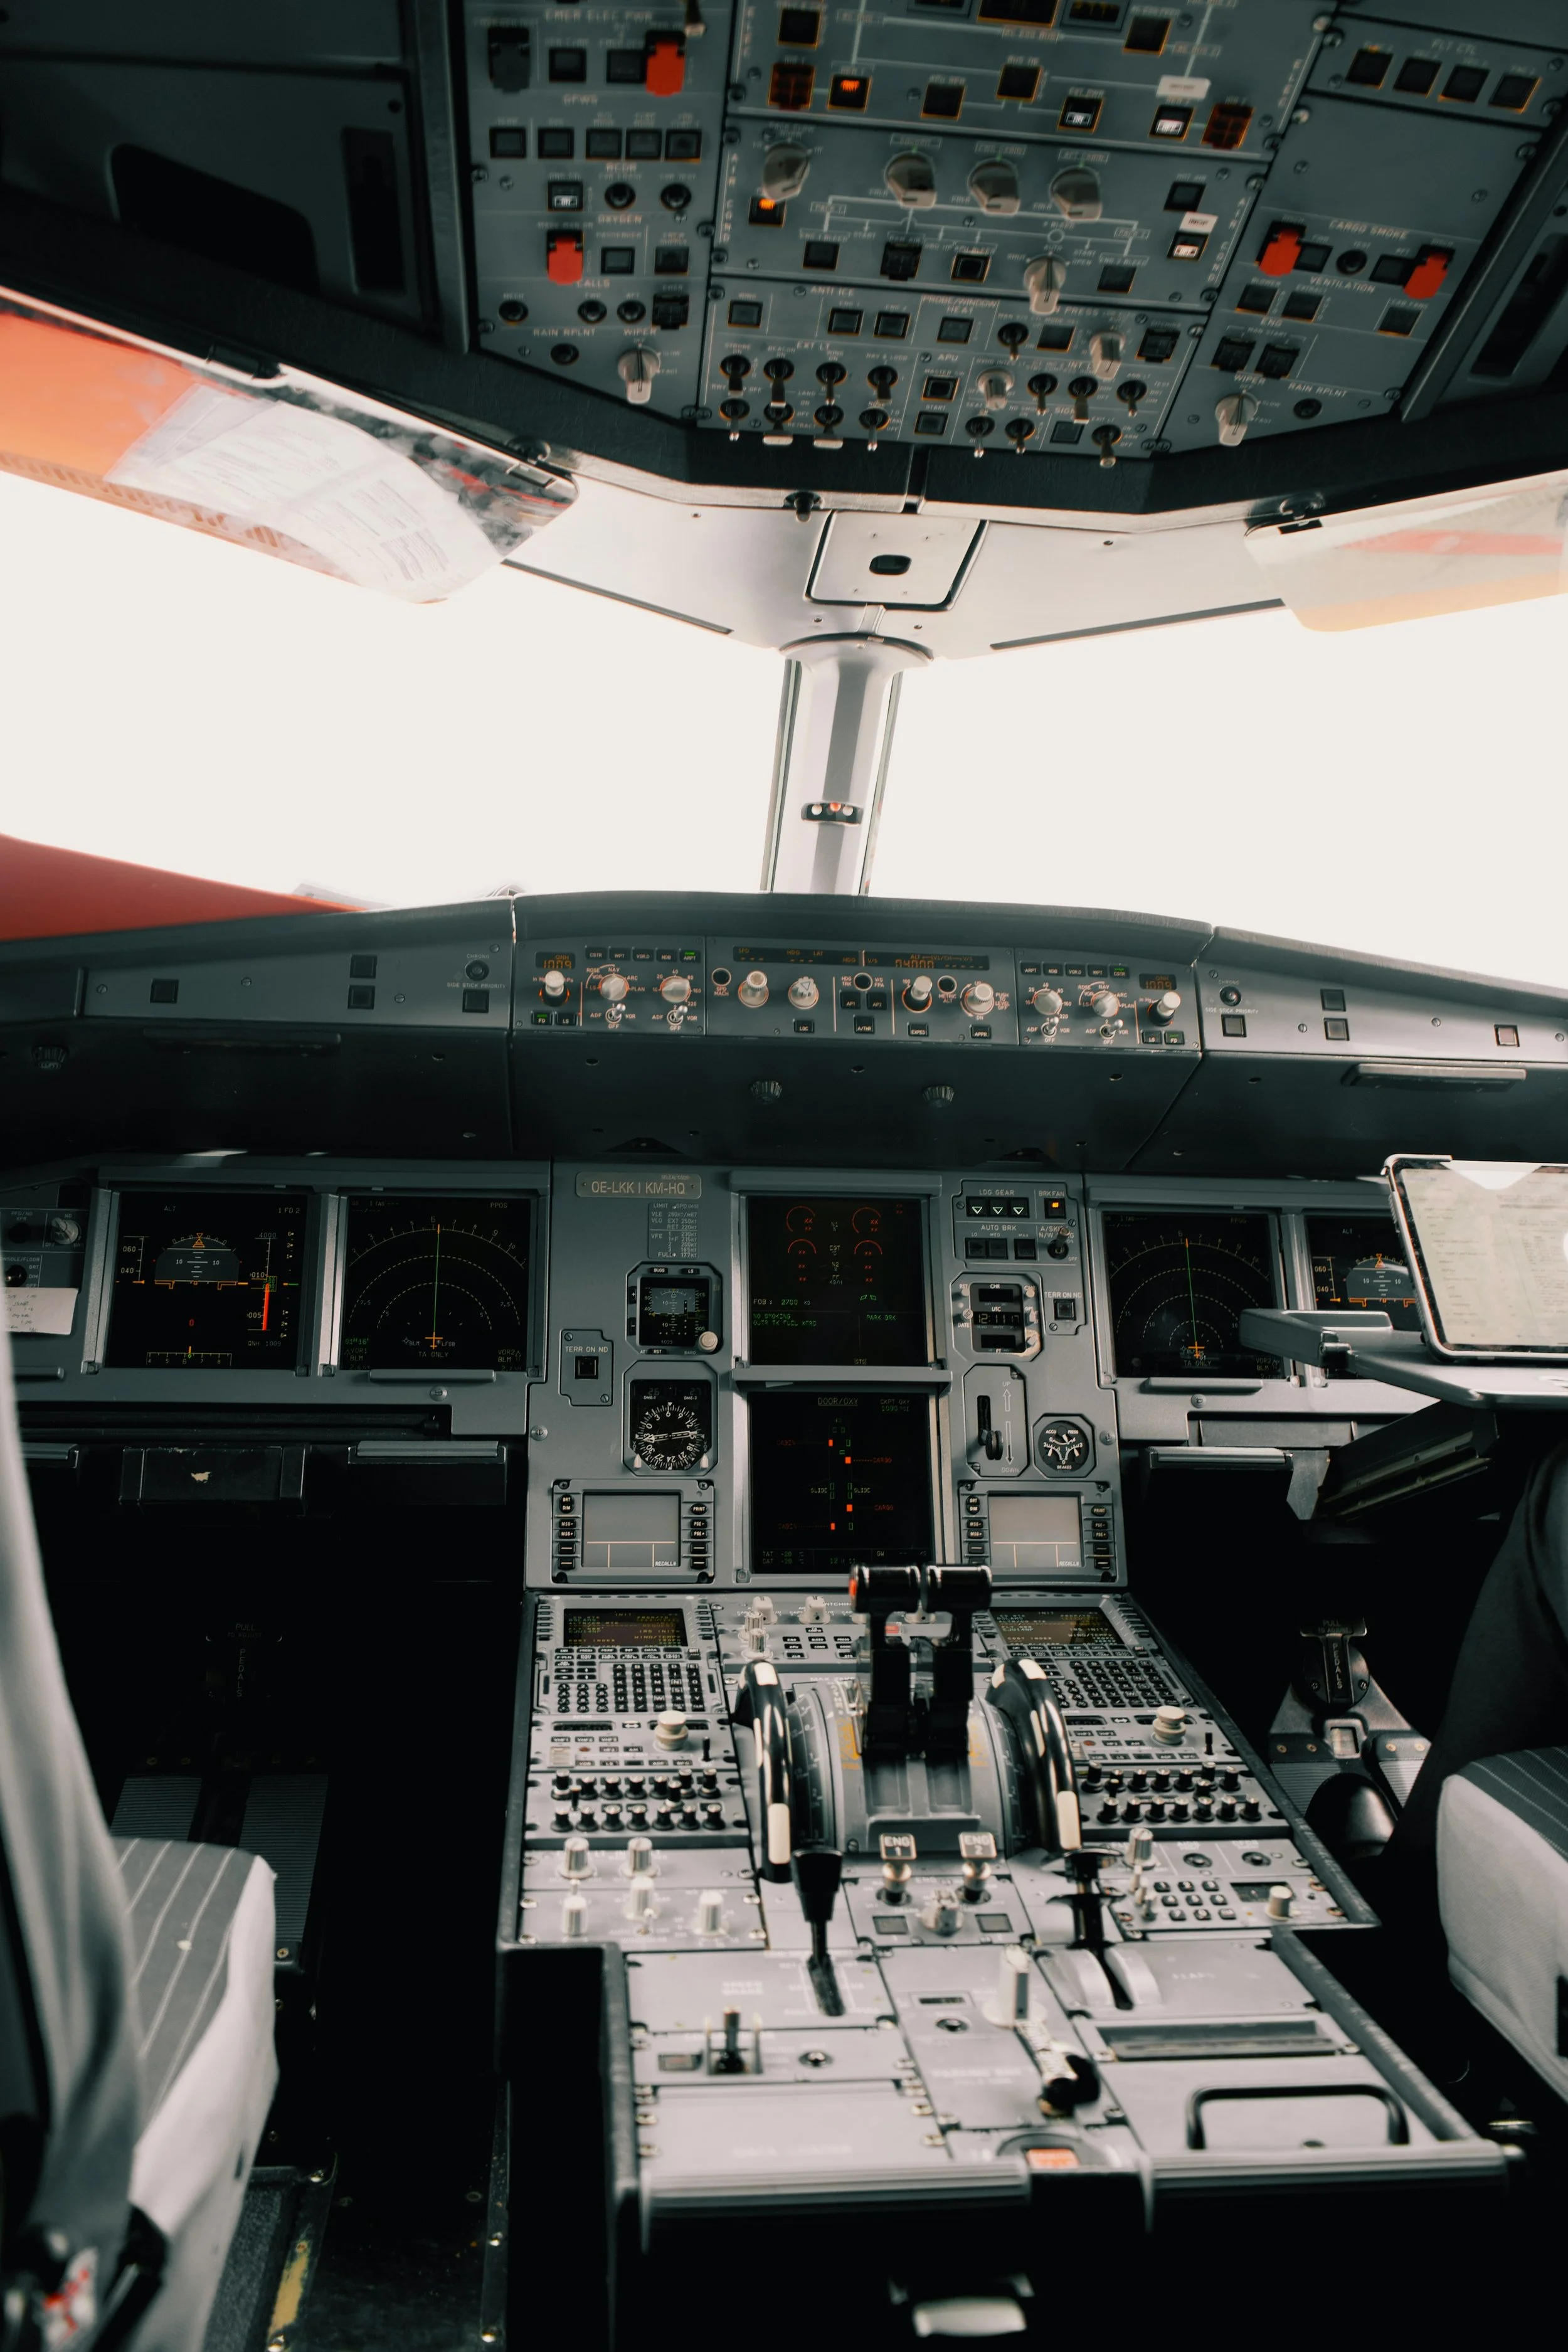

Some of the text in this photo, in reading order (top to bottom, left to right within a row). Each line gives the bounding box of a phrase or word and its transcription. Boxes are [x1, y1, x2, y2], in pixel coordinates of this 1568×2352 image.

[598, 215, 642, 224] OXYGEN
[1330, 221, 1409, 240] CARGO SMOKE
[1310, 276, 1375, 294] VENTILATION
[1064, 308, 1098, 316] PRESS
[1261, 319, 1282, 327] ENG
[1234, 373, 1266, 386] WIPER
[1288, 383, 1313, 393] RAIN
[591, 1181, 686, 1195] OE-LKK KM-HQ
[236, 1648, 246, 1697] PEDALS
[885, 1836, 910, 1846] ENG
[965, 1835, 990, 1845] ENG
[974, 1845, 982, 1854] 2
